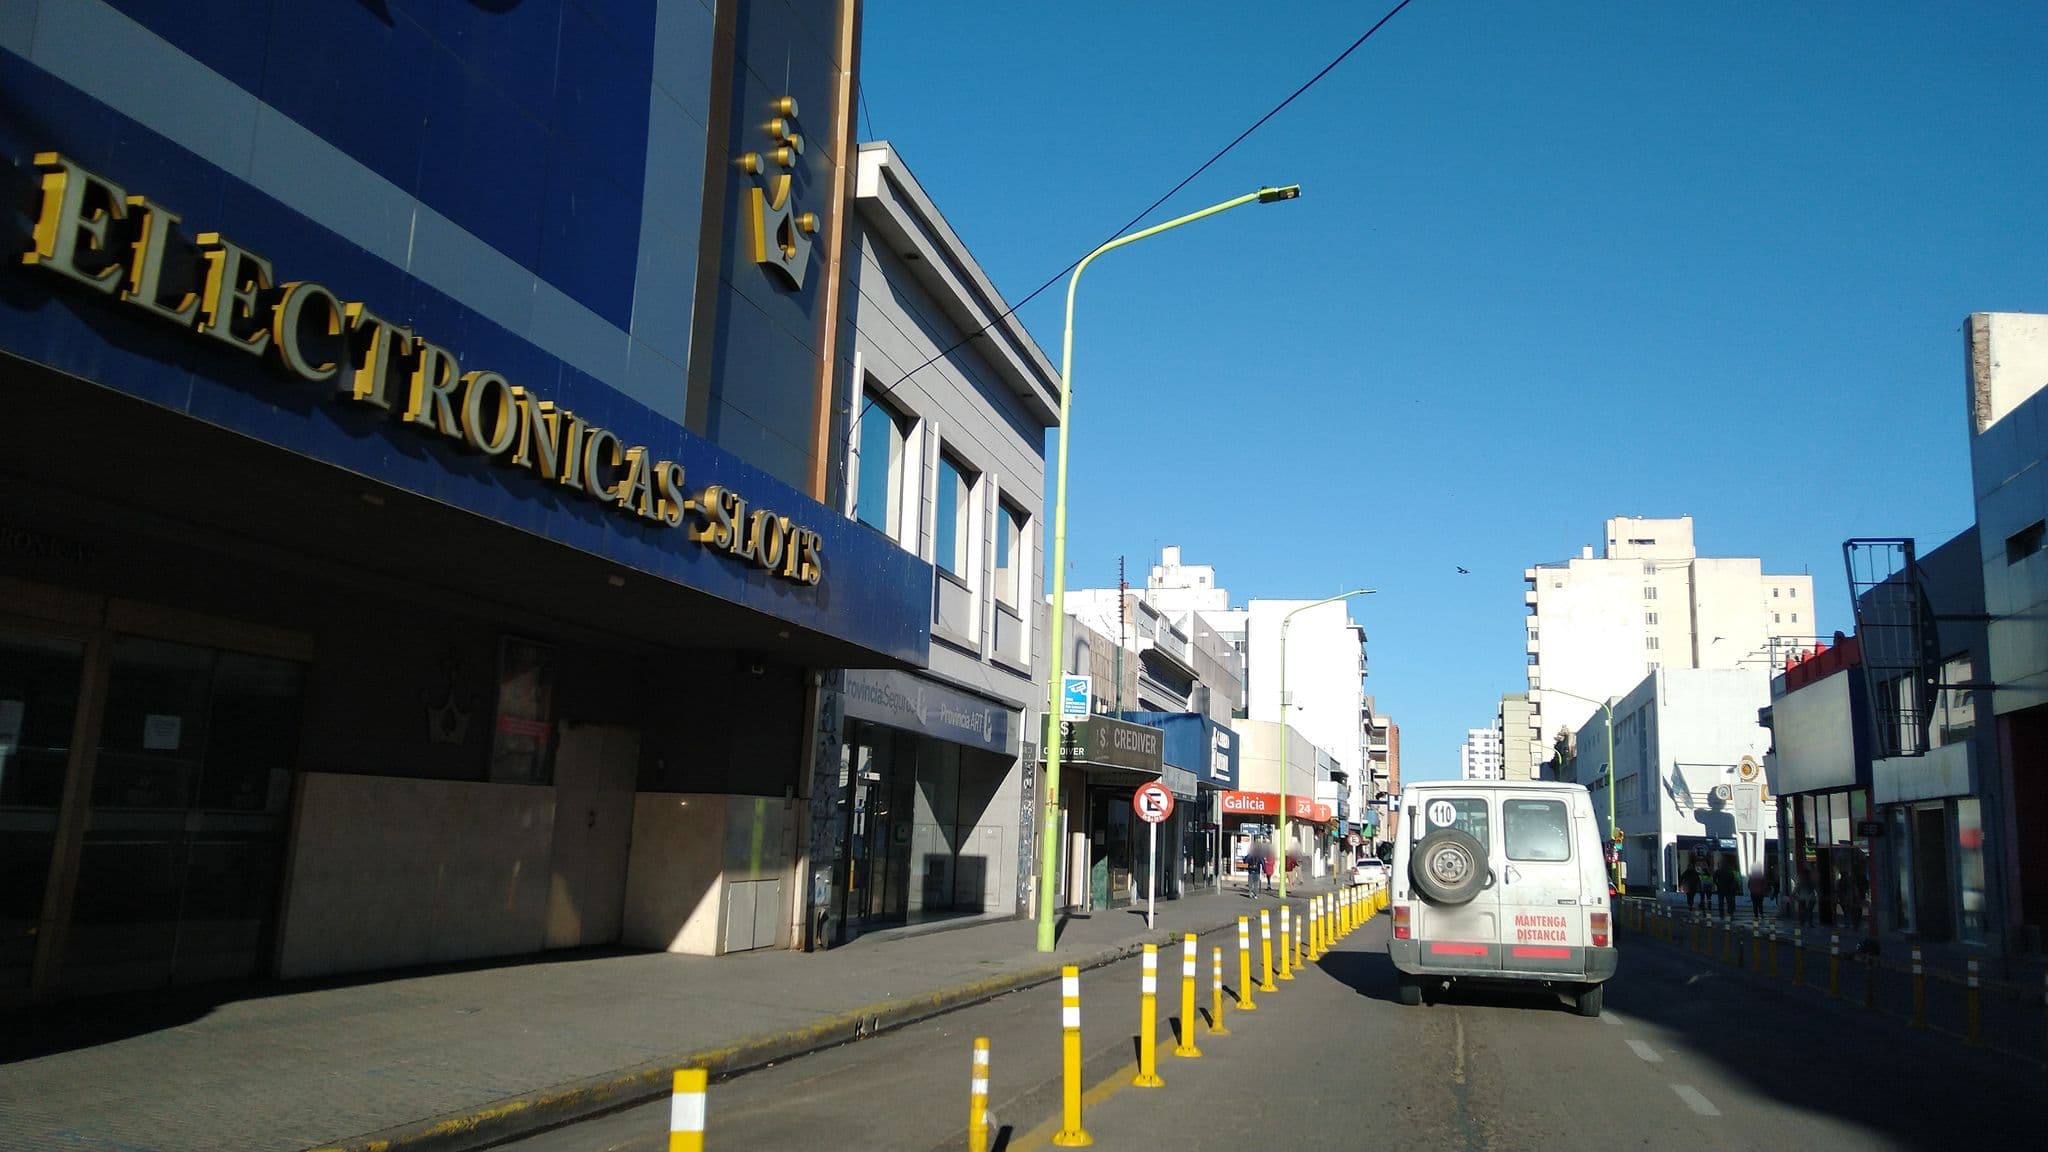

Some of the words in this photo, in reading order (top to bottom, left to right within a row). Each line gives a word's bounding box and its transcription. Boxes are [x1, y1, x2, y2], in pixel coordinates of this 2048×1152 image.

[1114, 727, 1157, 755] CREDIVER
[1043, 747, 1085, 756] CDIVER
[1225, 796, 1265, 811] Galicia
[1299, 804, 1311, 814] 24
[1435, 805, 1451, 823] 110
[1515, 915, 1567, 927] MANTENGA
[1517, 929, 1566, 941] DISTANCIA
